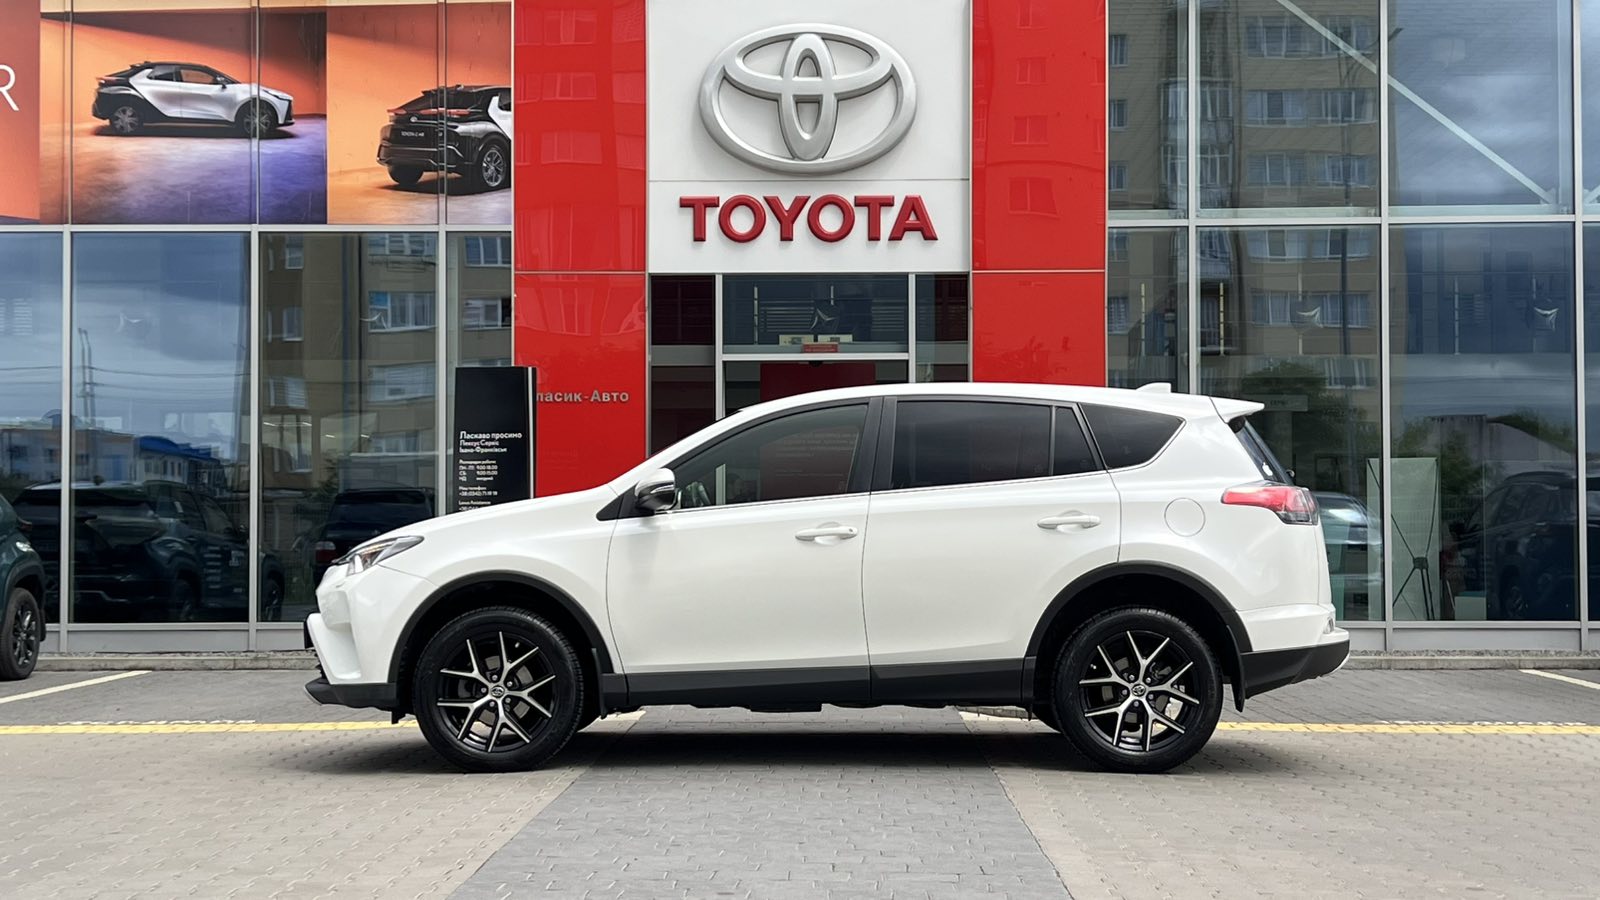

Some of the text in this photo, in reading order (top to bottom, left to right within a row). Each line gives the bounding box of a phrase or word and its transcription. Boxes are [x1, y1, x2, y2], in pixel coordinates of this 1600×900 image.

[679, 194, 939, 243] TOYOTA
[536, 389, 630, 402] ласик-Авто
[459, 430, 523, 440] Ласкаво просимо
